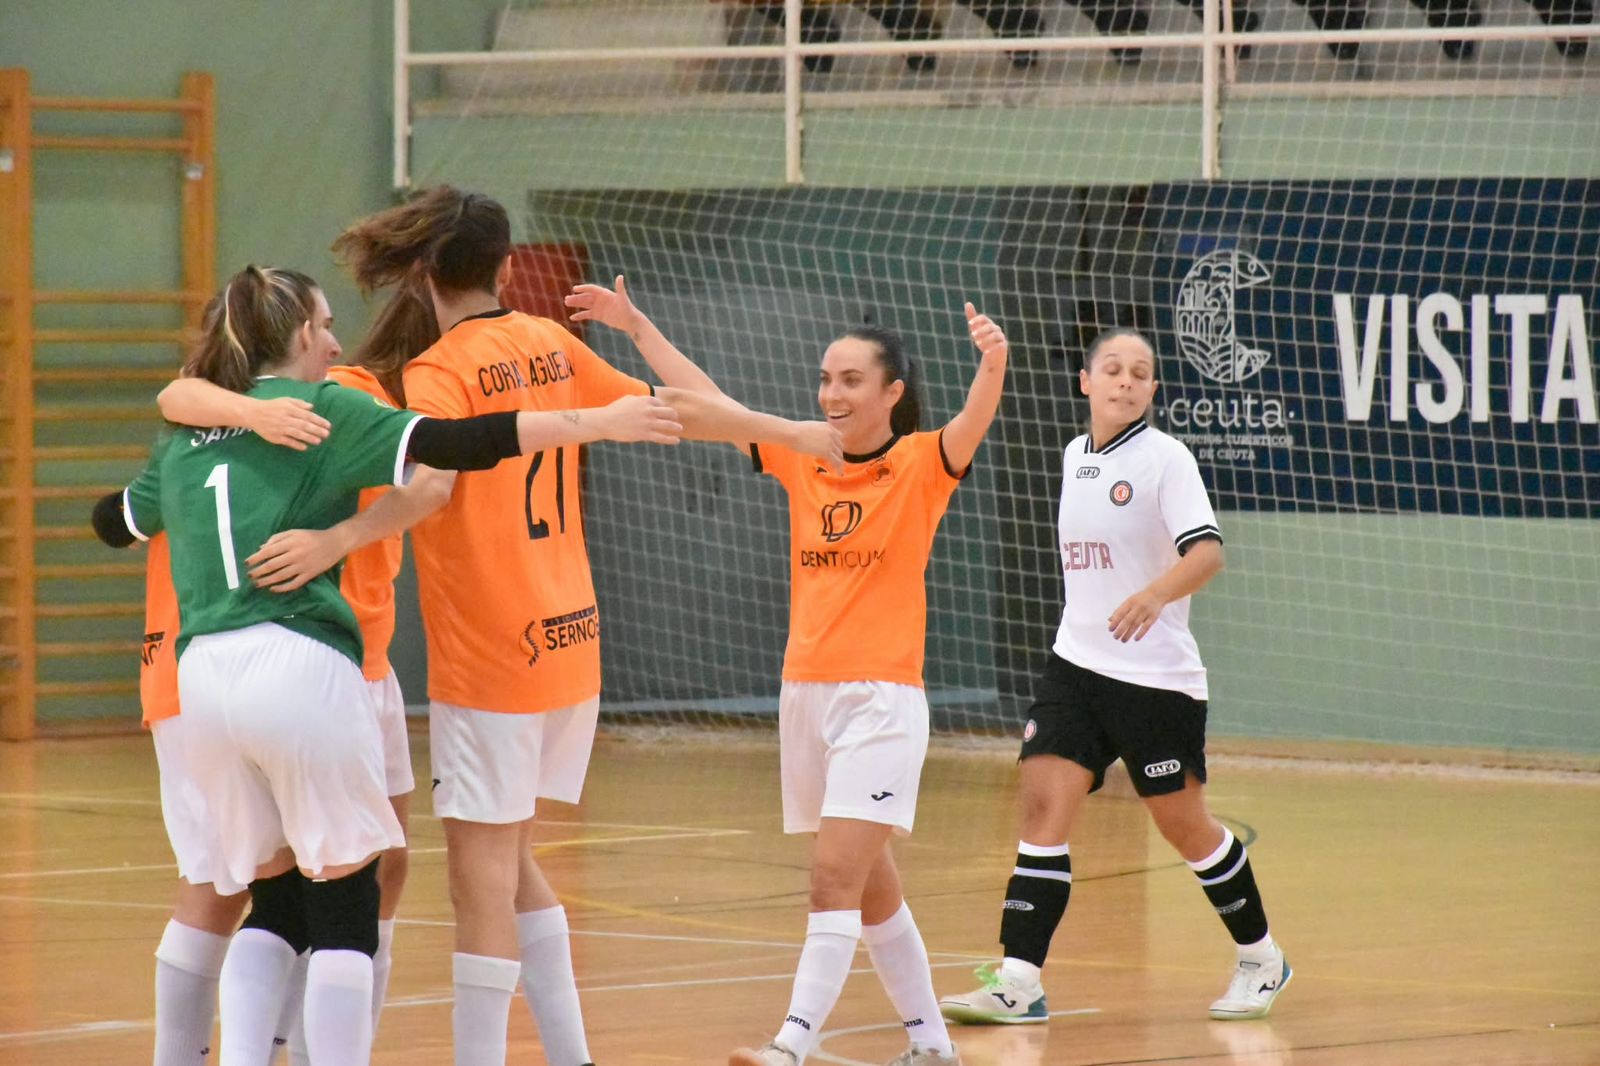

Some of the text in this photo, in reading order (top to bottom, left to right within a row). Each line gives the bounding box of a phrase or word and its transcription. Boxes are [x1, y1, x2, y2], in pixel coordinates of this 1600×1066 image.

[1333, 293, 1598, 424] VISITA
[1169, 394, 1285, 428] ceuta
[203, 463, 240, 590] 1
[544, 614, 600, 651] SERNO
